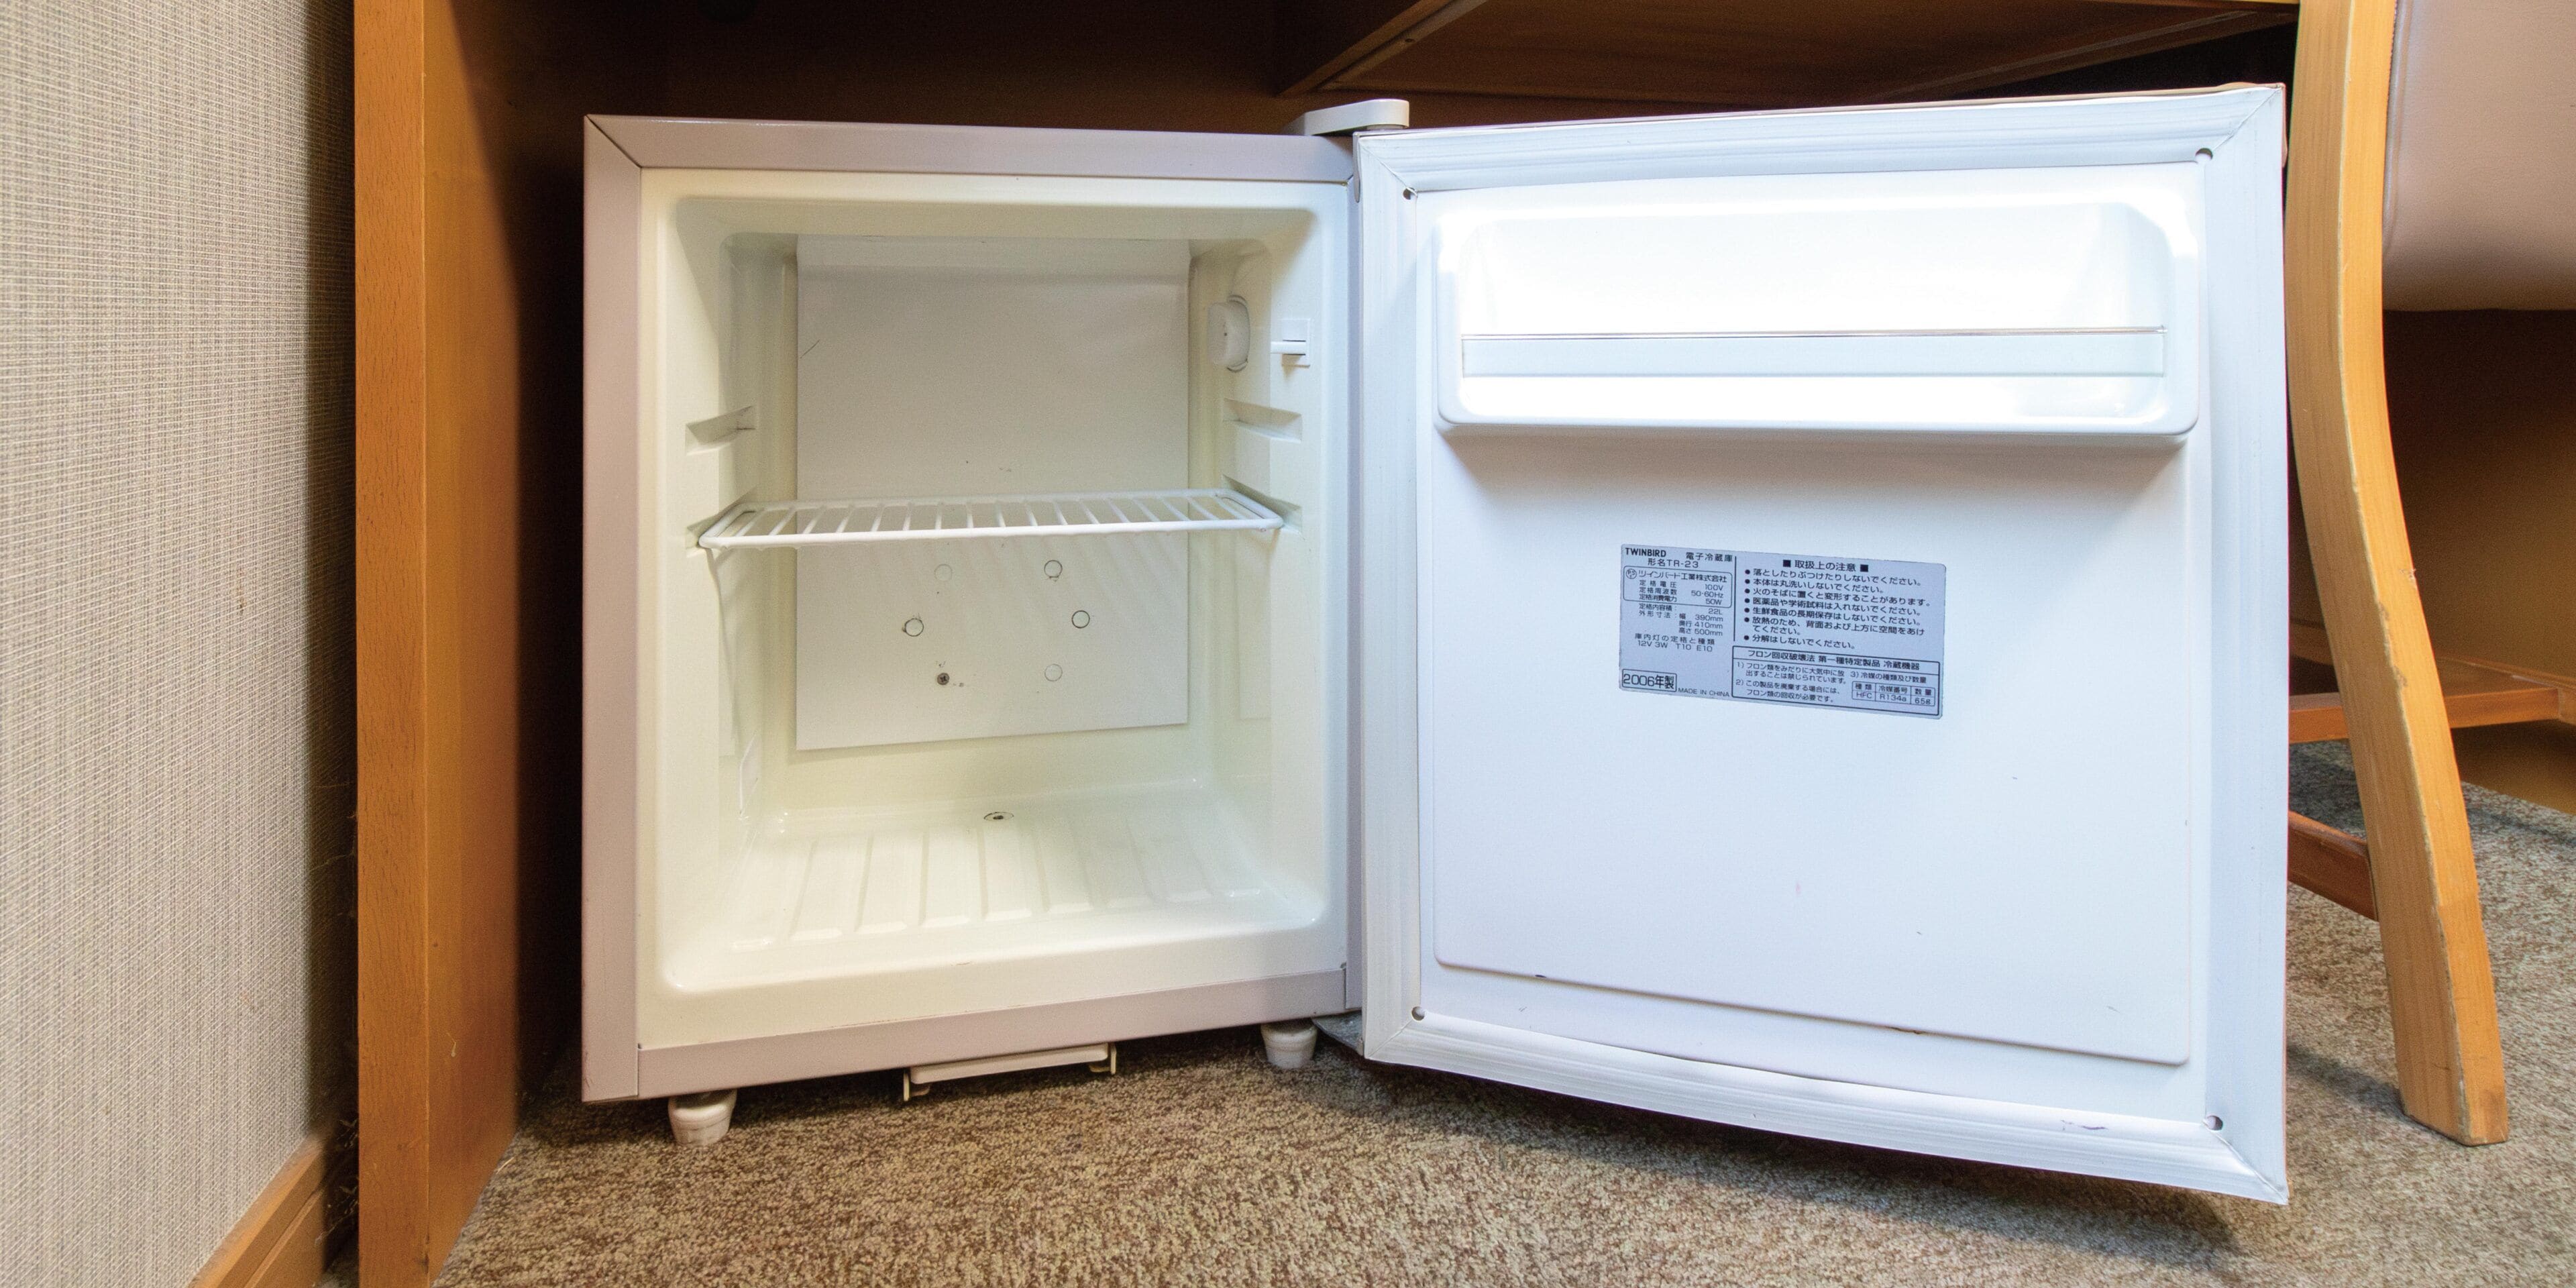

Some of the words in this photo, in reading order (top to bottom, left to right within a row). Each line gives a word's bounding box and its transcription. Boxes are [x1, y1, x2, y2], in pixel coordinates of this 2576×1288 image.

[1625, 548, 1666, 557] TWINBIRD
[1686, 552, 1733, 562] 電子冷蔵庫
[1648, 558, 1699, 568] 形名TR-23
[1794, 559, 1856, 572] 取扱上の注意
[1638, 570, 1727, 583] ツインバード工業株式会社
[1753, 568, 1921, 586] 落としたりぶつけたりしないでください。
[1640, 580, 1677, 588] 定格電圧
[1753, 578, 1883, 593] 本体は丸洗いしないでください。
[1639, 587, 1677, 595] 定格周波数
[1639, 594, 1677, 602] 定格消費電力
[1753, 606, 1920, 625] 生鮮食品の長期保存はしないでください。
[1694, 621, 1723, 629] 410mm
[1753, 625, 1801, 635] てください。
[1694, 629, 1723, 637] 500mm
[1752, 635, 1855, 649] 分解はしないでください。
[1748, 650, 1815, 662] フロン回収破壊法
[1819, 655, 1880, 667] 第一種特定製品
[1623, 674, 1674, 689] 2006年製
[1880, 694, 1907, 702] R134a
